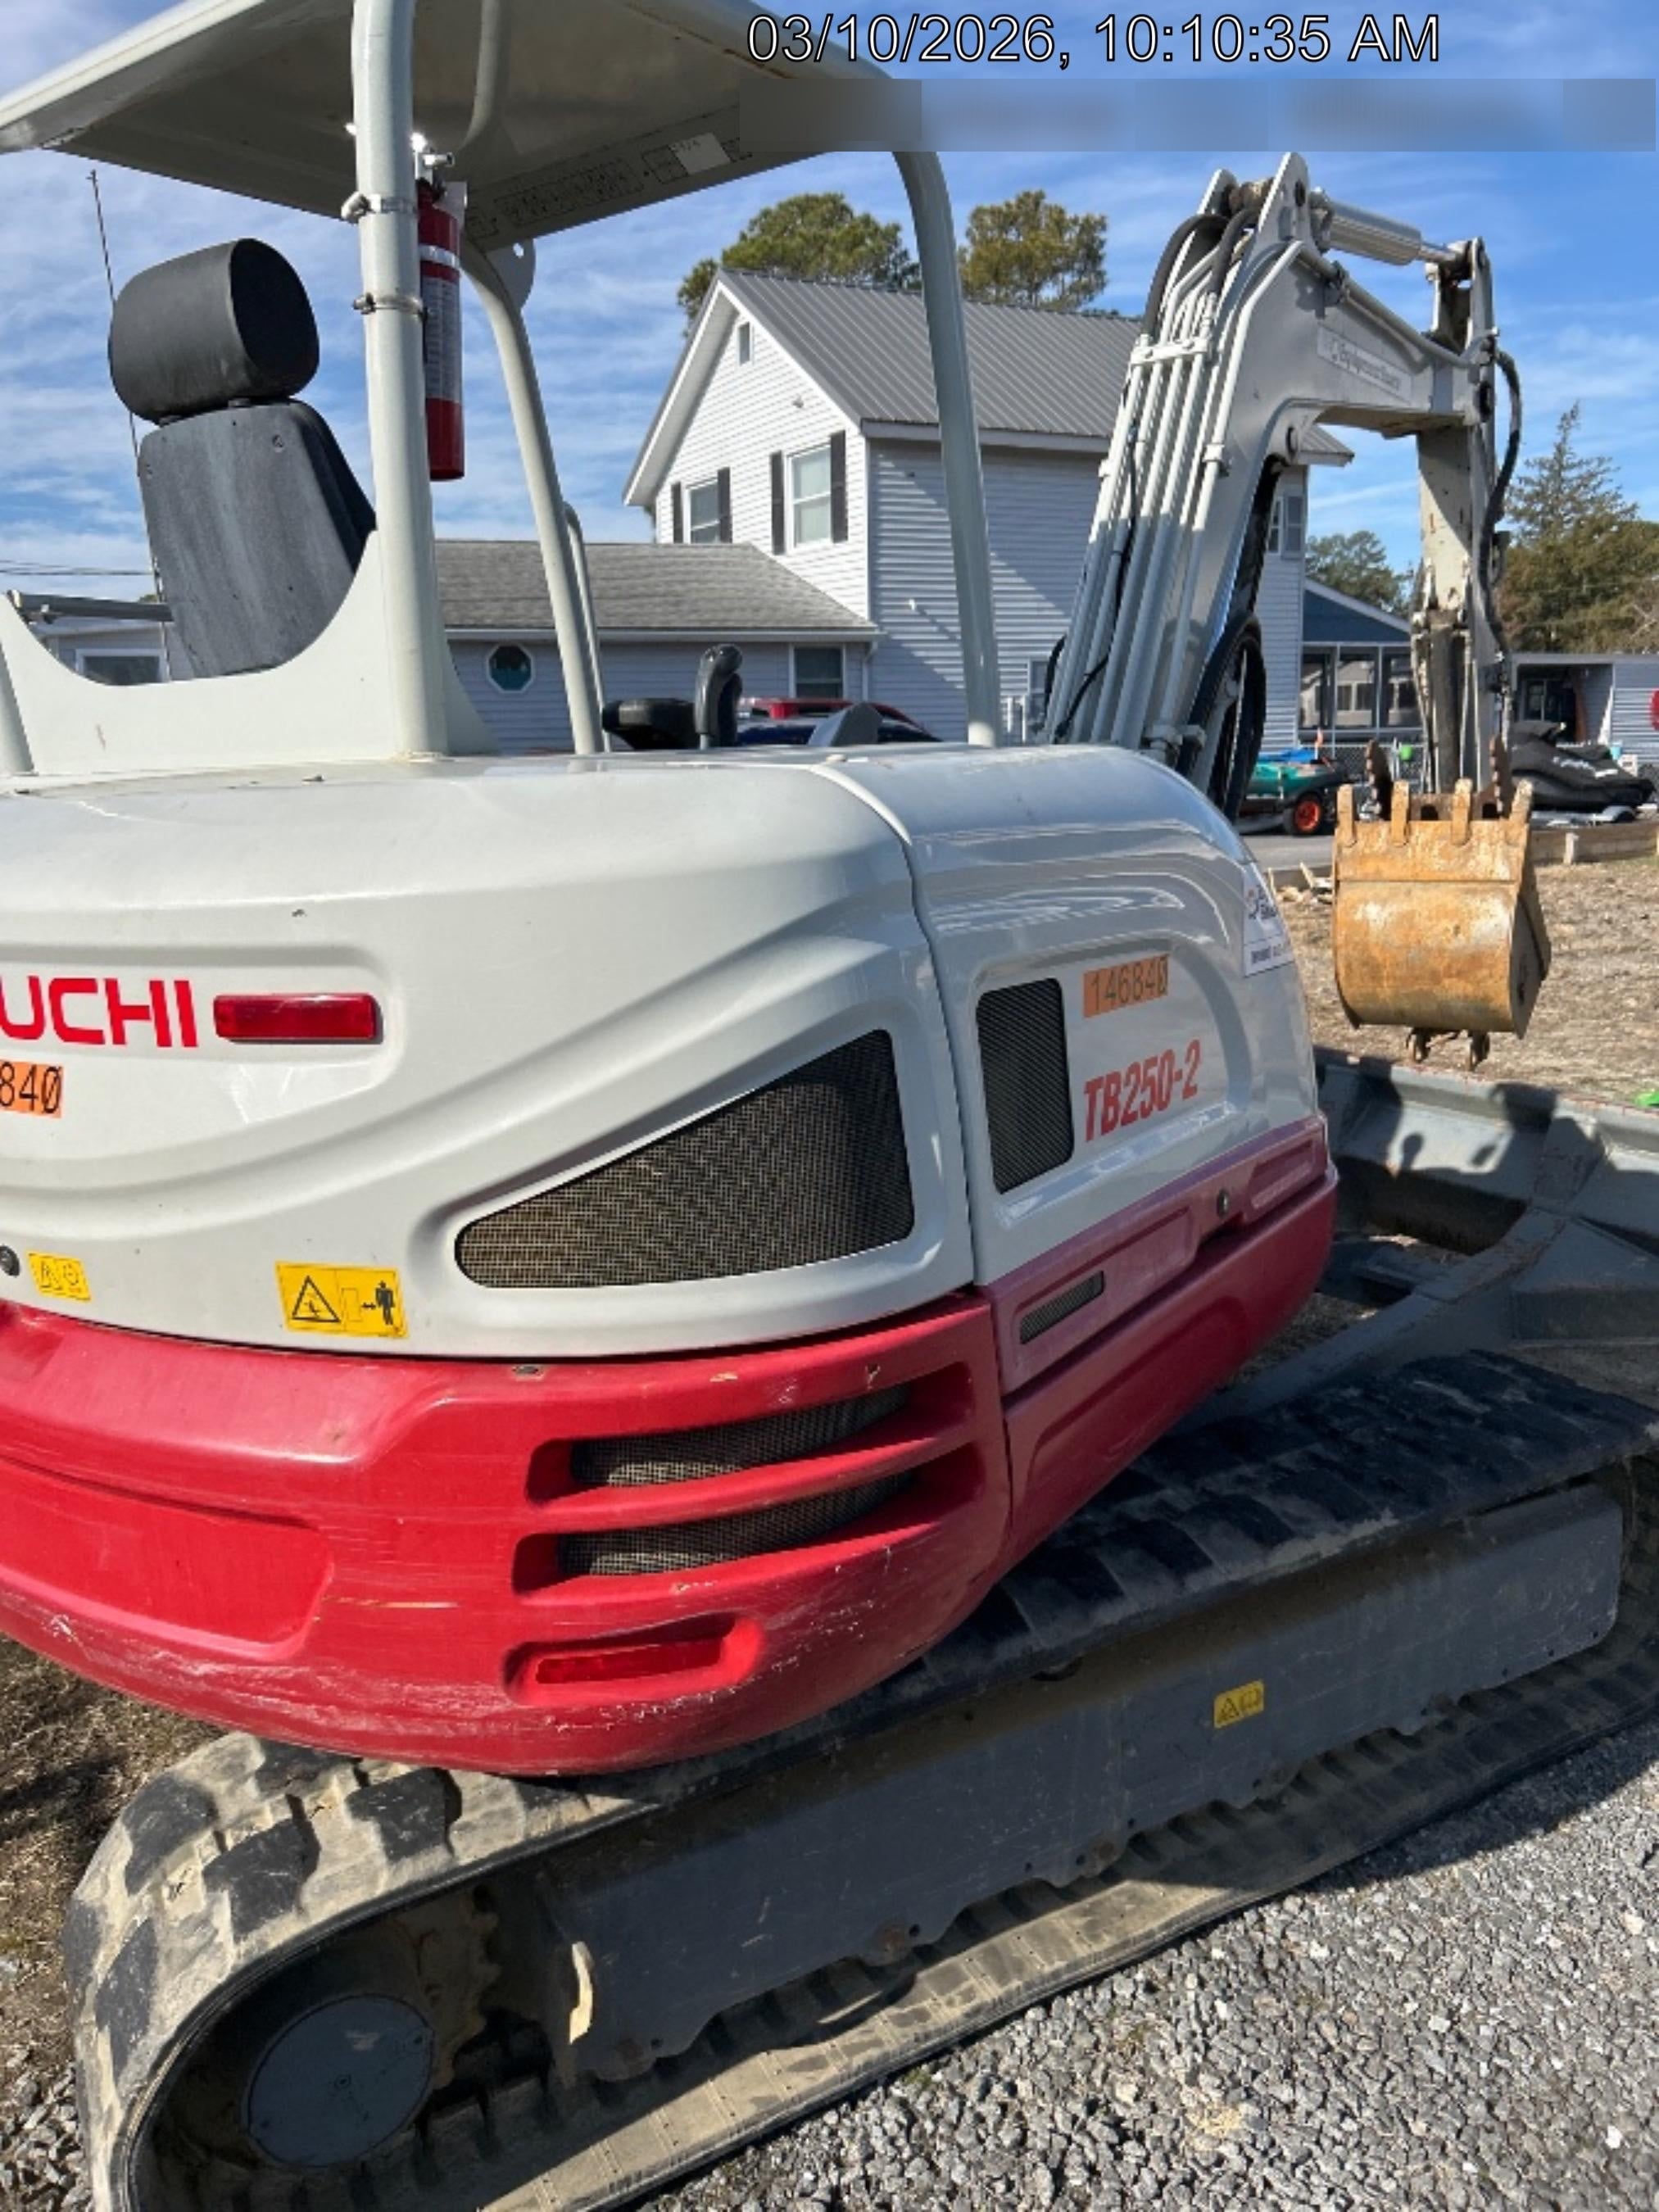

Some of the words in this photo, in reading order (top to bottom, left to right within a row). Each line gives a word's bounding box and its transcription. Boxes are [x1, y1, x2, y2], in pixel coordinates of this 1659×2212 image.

[0, 976, 198, 1047] UCHI
[1090, 954, 1168, 1013] 146840
[1083, 1039, 1202, 1142] TB250-2
